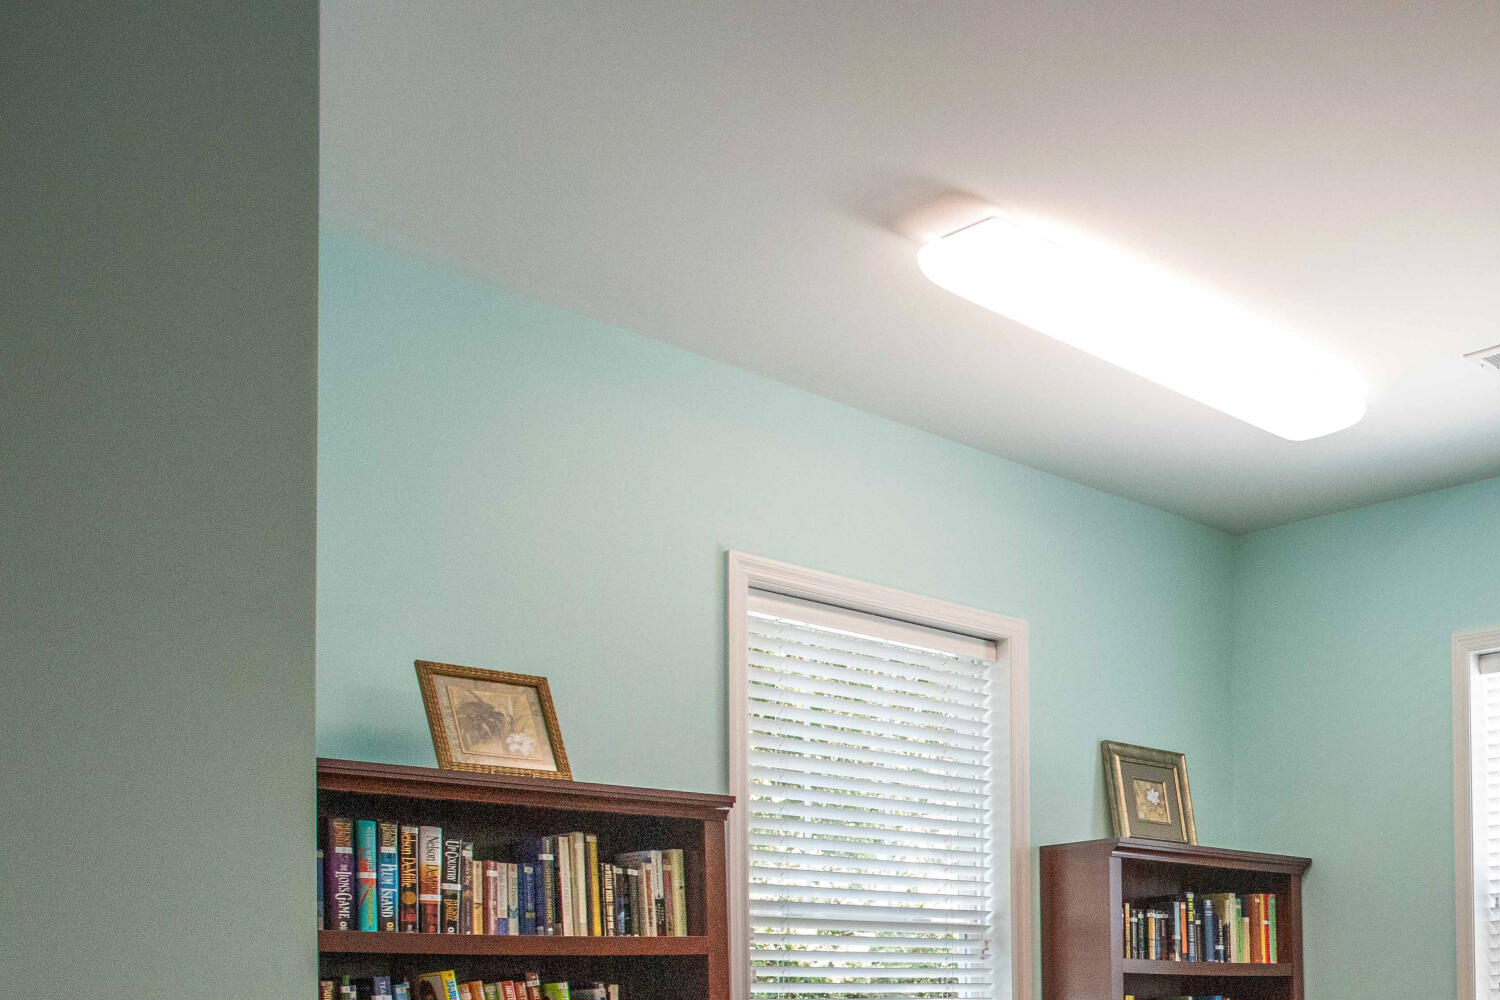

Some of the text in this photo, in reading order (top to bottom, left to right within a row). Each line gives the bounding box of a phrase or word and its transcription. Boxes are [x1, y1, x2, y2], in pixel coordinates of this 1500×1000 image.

[425, 835, 440, 861] Nelson
[401, 857, 416, 888] DeMille
[445, 851, 459, 882] COUNTRY
[335, 893, 352, 919] GAME
[381, 864, 395, 918] PLUM ISLAND
